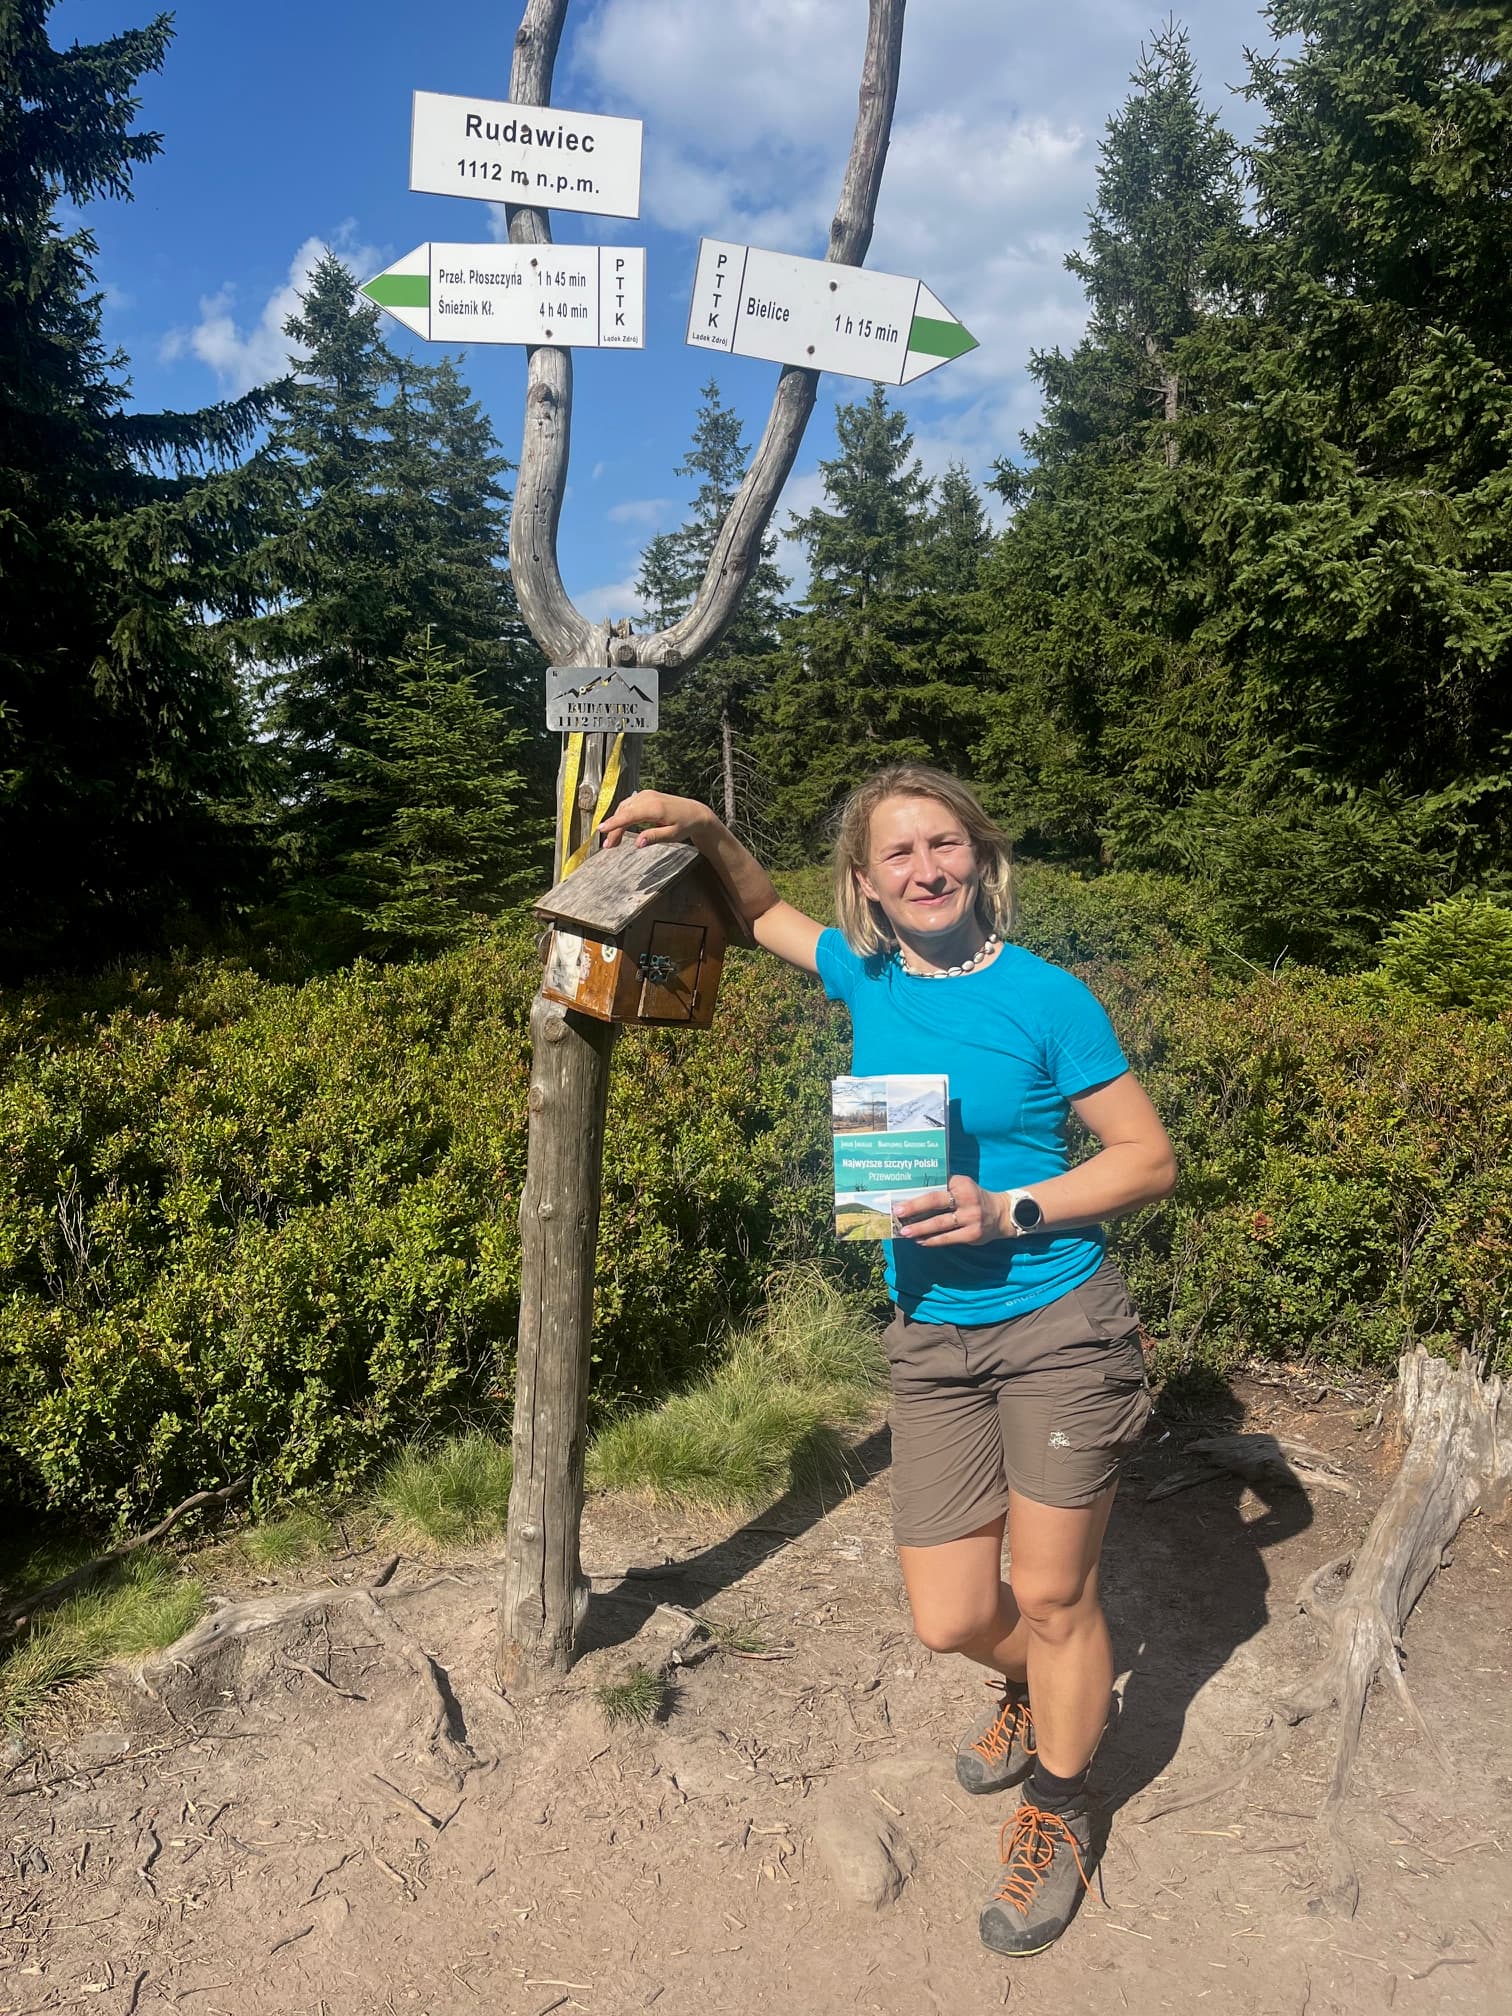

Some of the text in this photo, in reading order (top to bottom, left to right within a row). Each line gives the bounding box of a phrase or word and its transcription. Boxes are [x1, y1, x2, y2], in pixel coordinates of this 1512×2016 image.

[465, 113, 595, 153] Rudawiec
[457, 158, 599, 193] 1112 m n.p.m.
[439, 267, 522, 288] Przeł. Płoszczyna
[537, 270, 586, 287] 1 h 45 min
[438, 294, 495, 316] Śnieżnik Kł.
[539, 301, 588, 318] 4 h 40 min
[746, 297, 790, 322] Bielice
[835, 313, 899, 343] 1 h 15 min
[914, 1158, 938, 1168] Polski
[868, 1172, 912, 1182] Przewodnik
